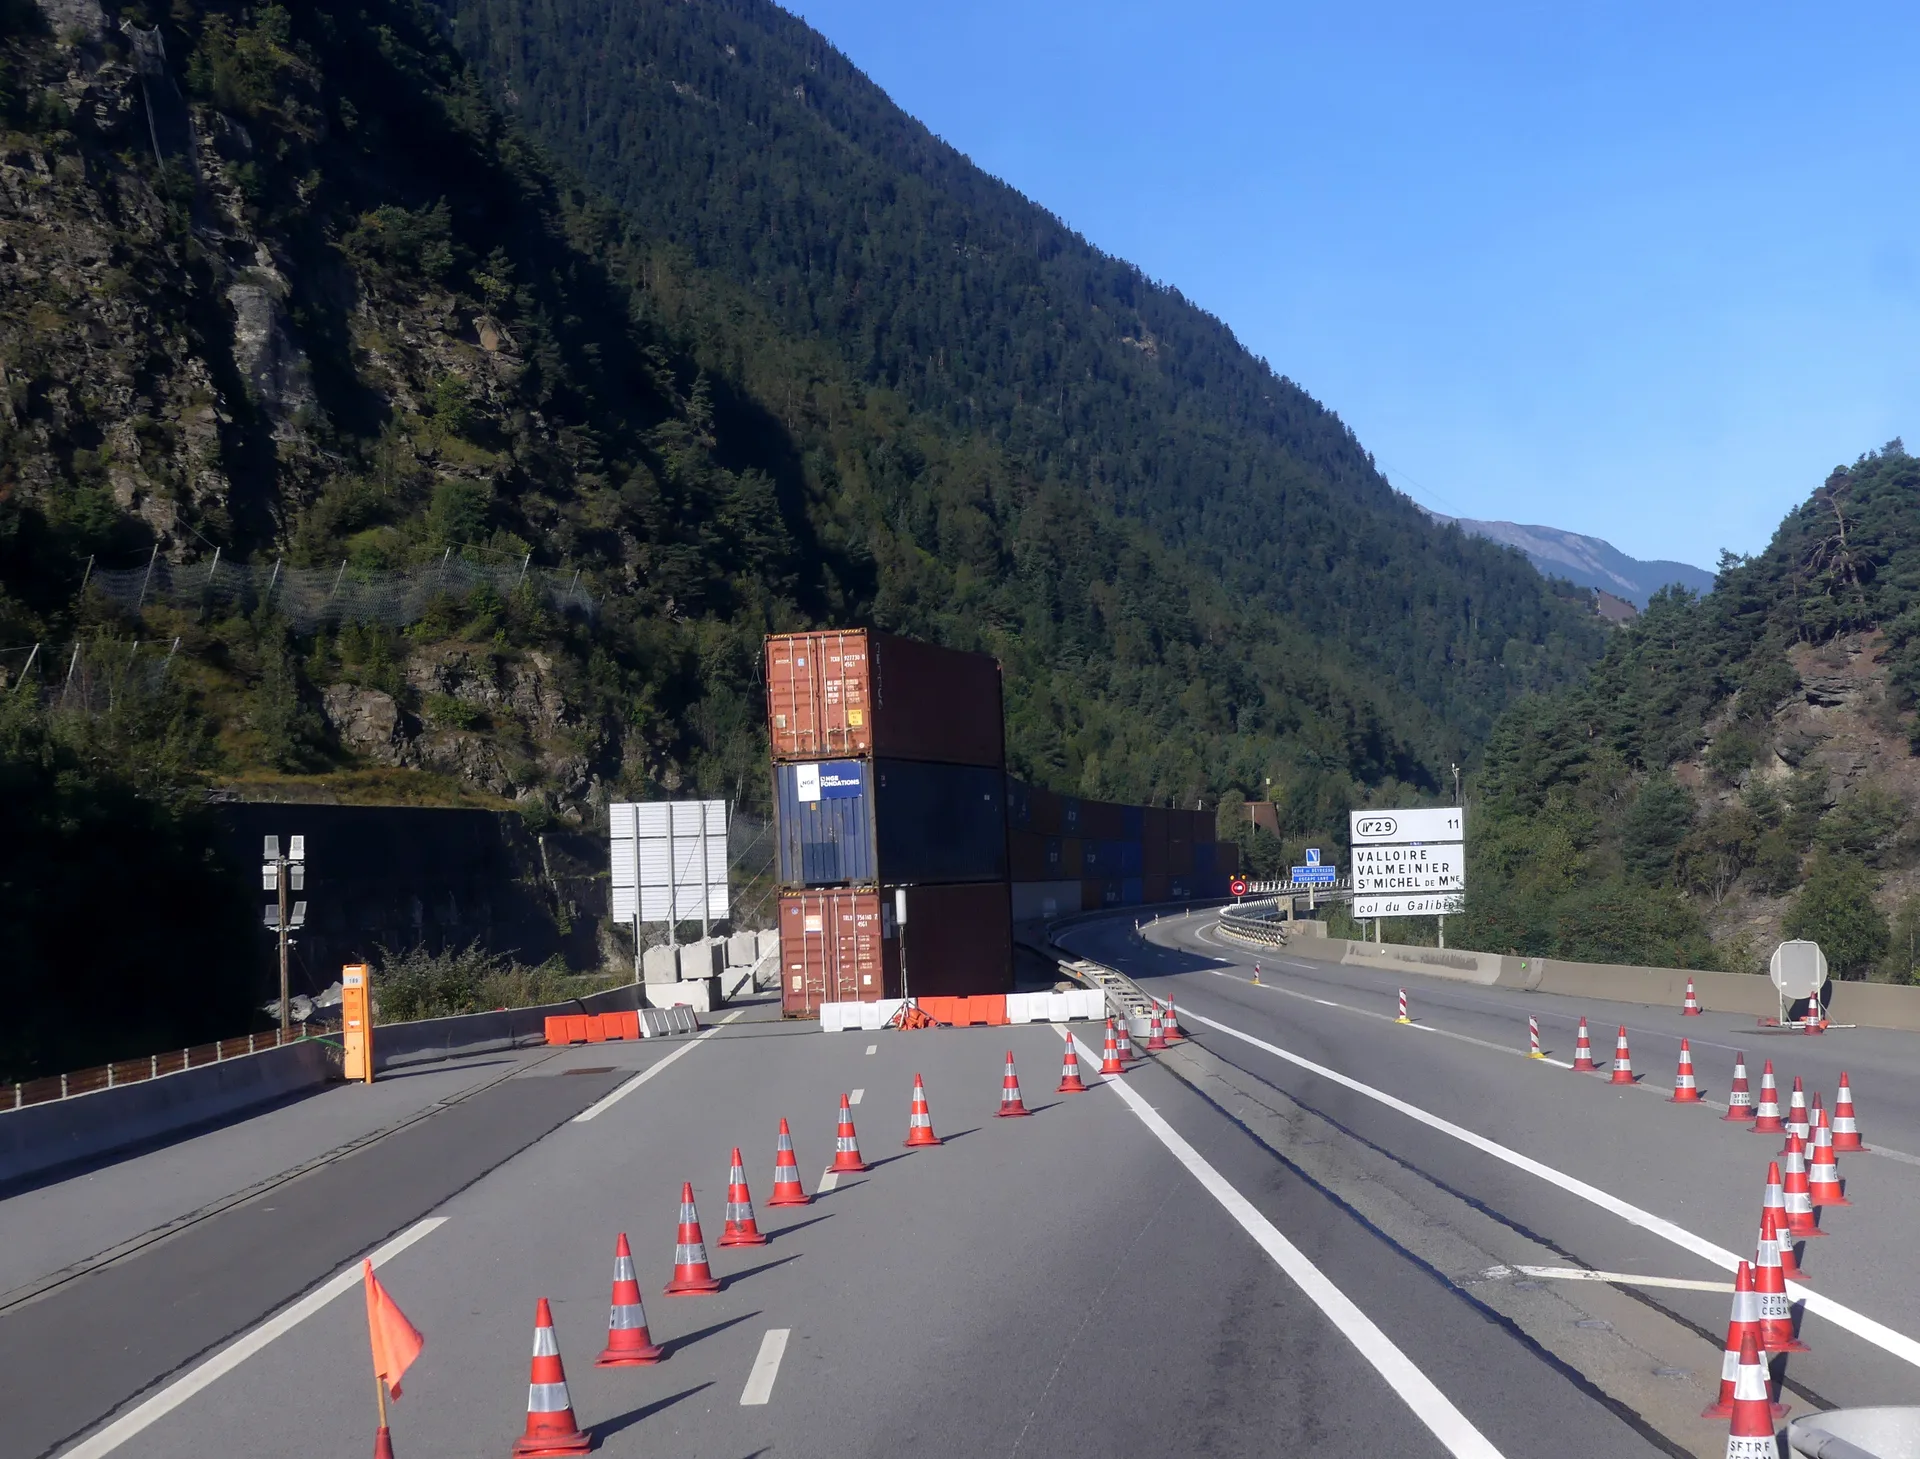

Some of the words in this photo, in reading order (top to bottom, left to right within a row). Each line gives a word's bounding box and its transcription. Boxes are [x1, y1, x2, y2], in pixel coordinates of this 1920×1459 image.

[820, 779, 860, 787] FONDATIONS
[1374, 821, 1392, 832] 29
[1447, 819, 1459, 829] 11
[1357, 850, 1428, 862] VALLOIRE
[1357, 863, 1450, 876] VALMEINIER
[1374, 876, 1421, 889] MICHEL
[1425, 879, 1435, 887] DE
[1359, 902, 1378, 913] col
[1385, 901, 1400, 912] du
[1762, 1295, 1788, 1305] SFTR
[1761, 1306, 1789, 1316] CESA
[1729, 1440, 1770, 1453] SFTRF
